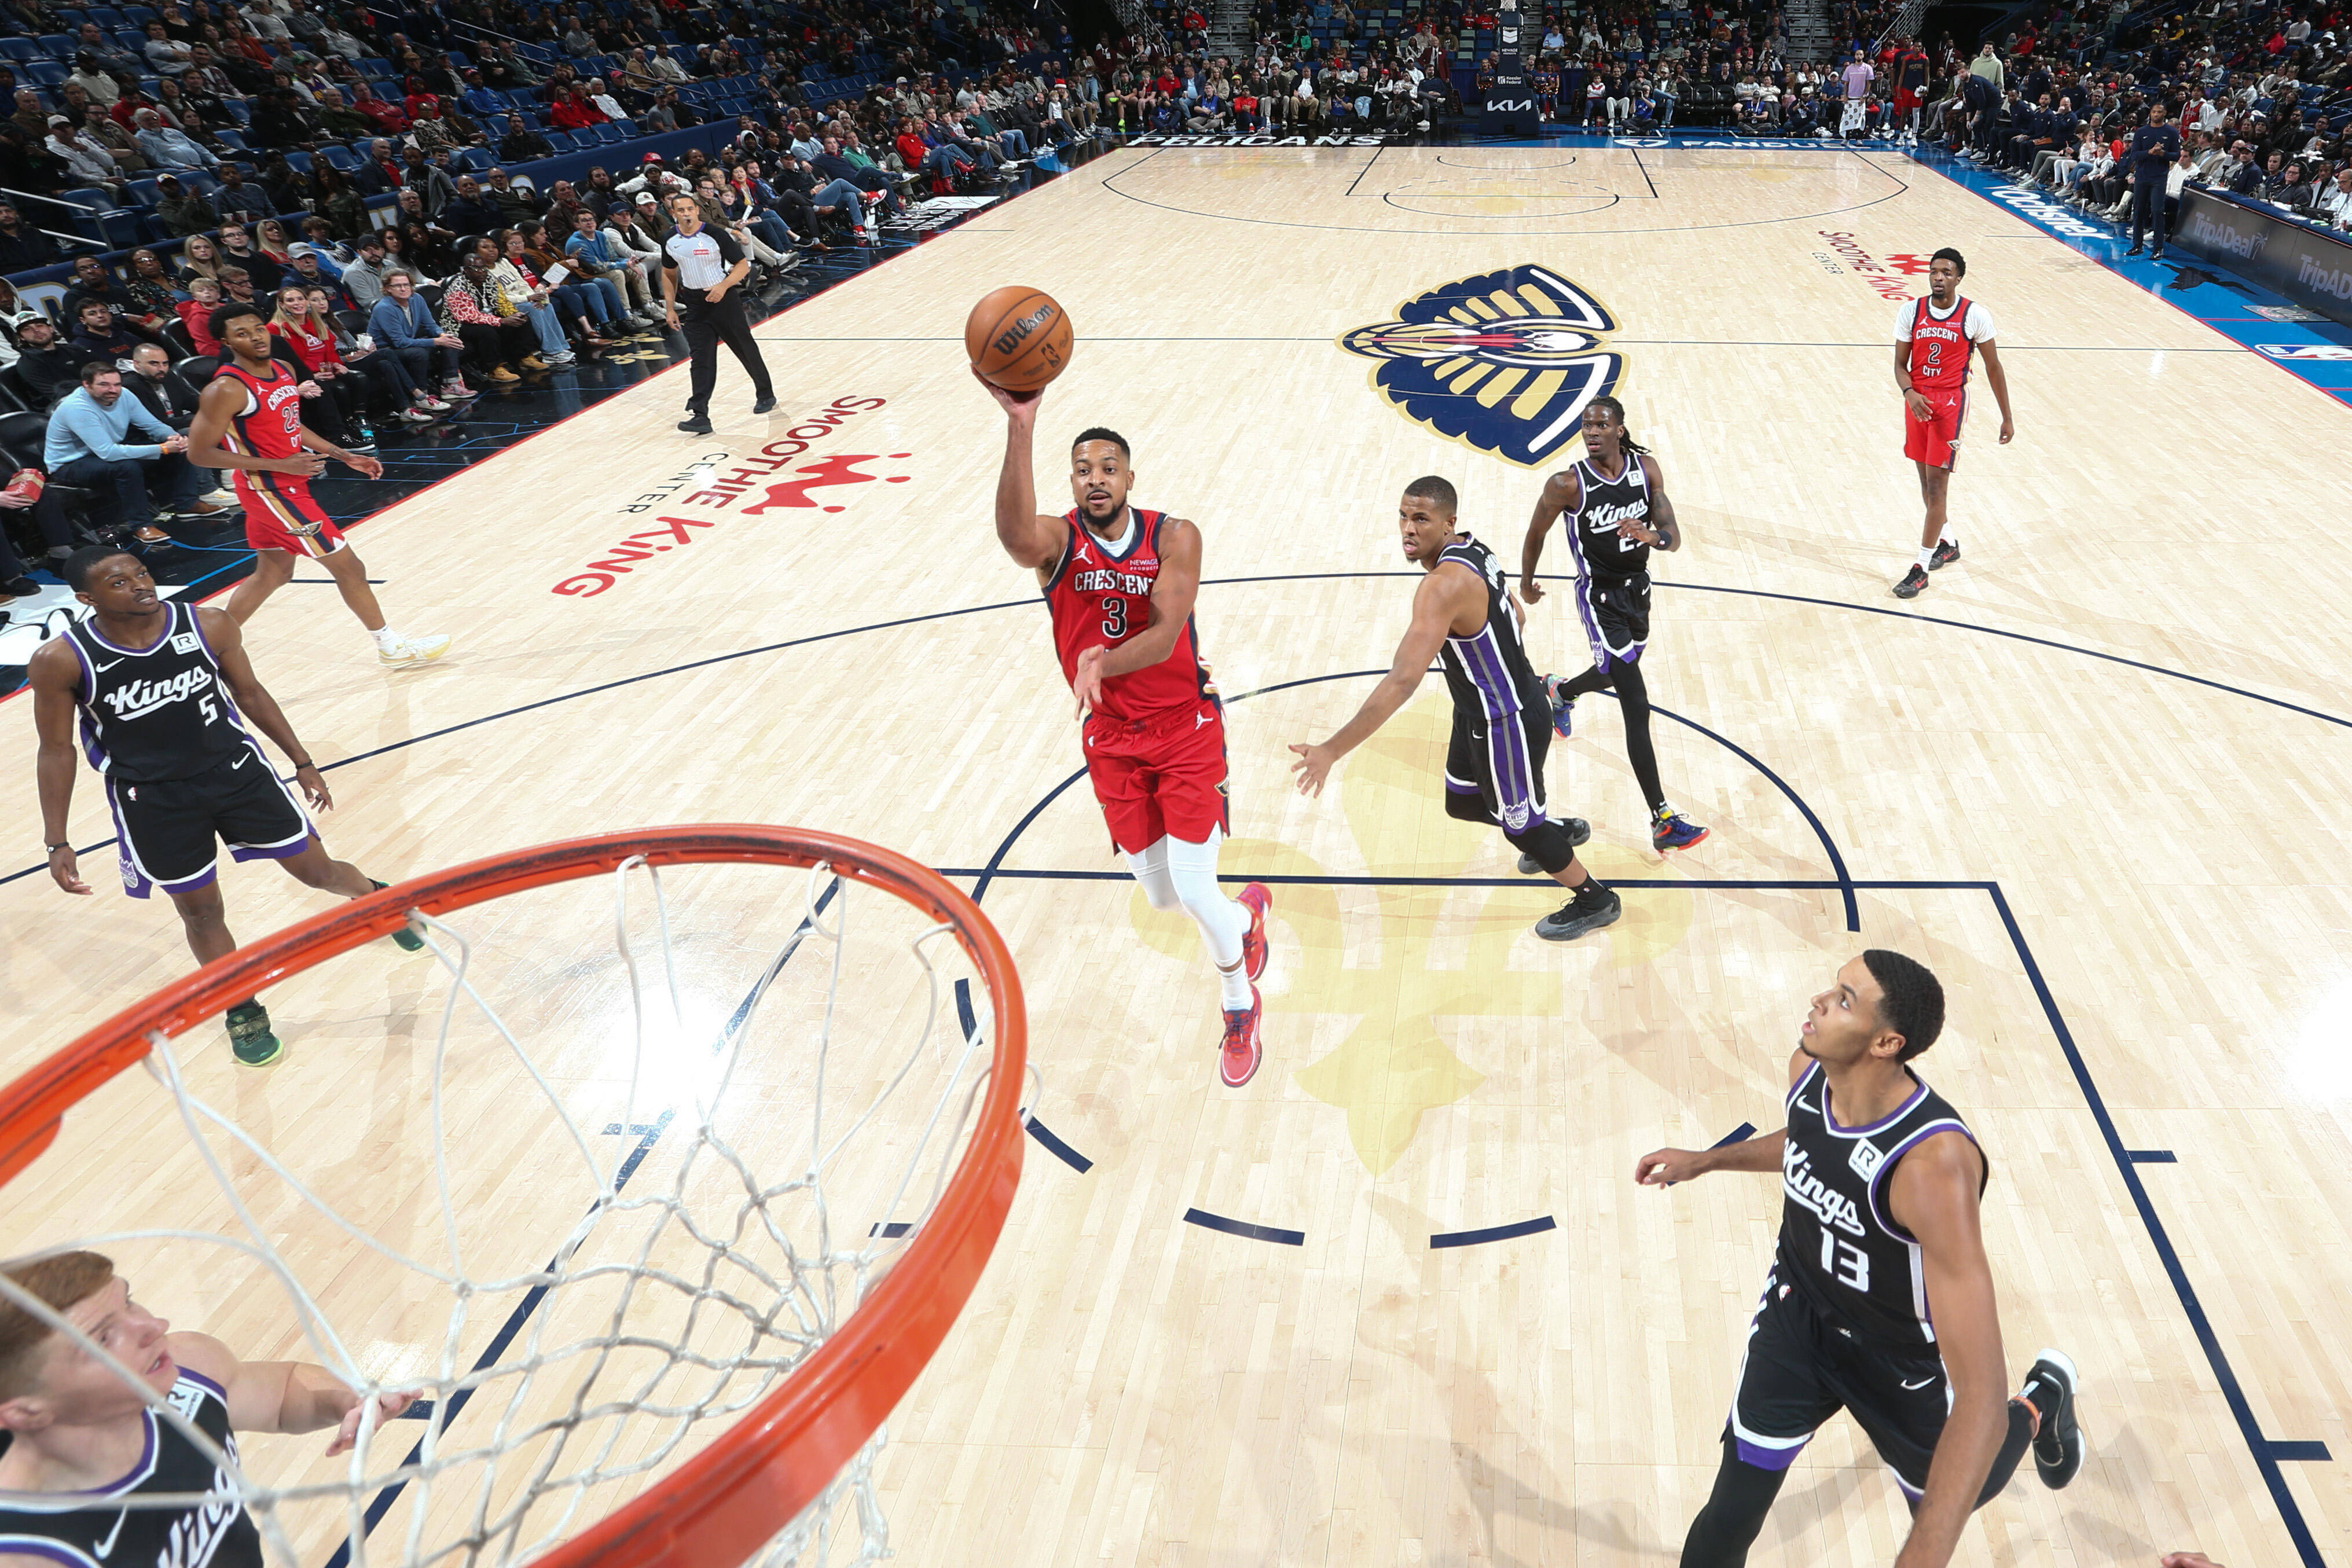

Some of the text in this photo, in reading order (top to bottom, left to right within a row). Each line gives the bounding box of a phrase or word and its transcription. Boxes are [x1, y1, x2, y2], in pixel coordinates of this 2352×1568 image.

[1126, 135, 1383, 145] PELICANS
[1682, 141, 1871, 149] FANDUEL
[1992, 191, 2114, 239] Ochsner
[2193, 212, 2256, 259] TripADeal
[1812, 252, 1844, 274] CENTER
[1818, 231, 1916, 301] SMOOTHIE KING
[2298, 253, 2352, 301] TripAD
[993, 304, 1055, 355] Wilson
[1916, 327, 1959, 343] CRESCENT
[1922, 365, 1942, 377] CITY
[1928, 342, 1942, 365] 2
[281, 401, 300, 434] 25
[552, 395, 886, 597] SMOOTHIE KING
[617, 453, 729, 513] CENTER
[1586, 498, 1649, 534] Kings
[1129, 558, 1158, 566] NEWAGE
[1102, 597, 1127, 638] 3
[104, 665, 212, 721] Kings
[199, 693, 218, 727] 5
[1783, 1137, 1866, 1237] Kings
[1820, 1225, 1869, 1292] 13
